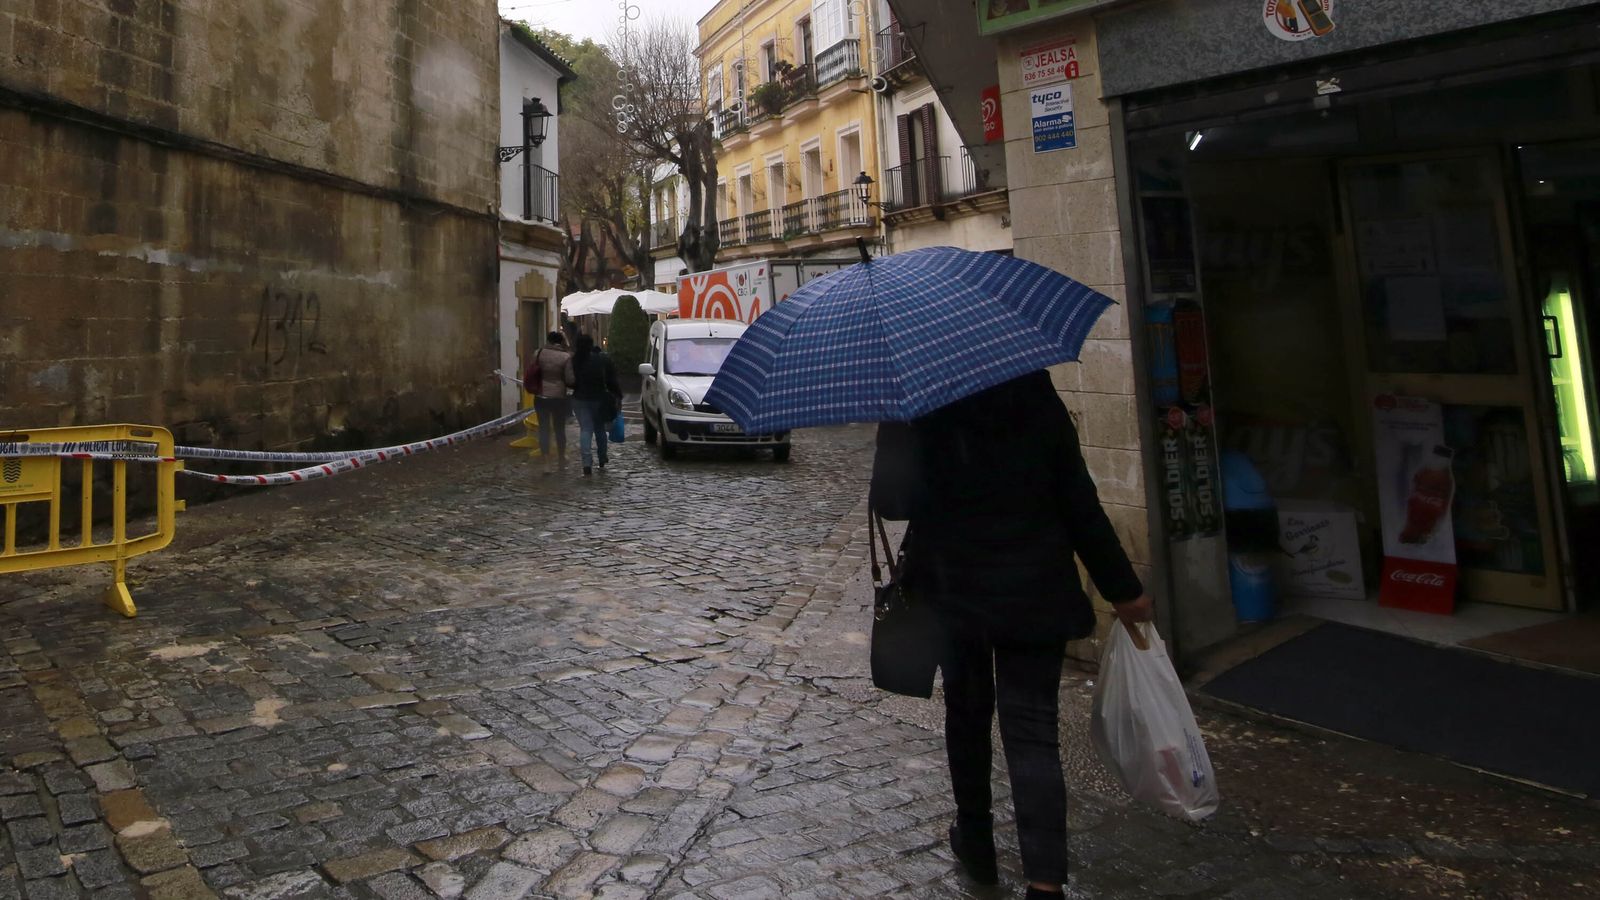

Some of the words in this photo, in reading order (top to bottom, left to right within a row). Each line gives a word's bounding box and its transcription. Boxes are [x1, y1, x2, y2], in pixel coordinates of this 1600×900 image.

[1035, 47, 1076, 68] JEALSA
[1038, 69, 1046, 78] 75
[1047, 68, 1055, 76] 58
[1056, 65, 1065, 73] 48
[1032, 90, 1062, 105] tyco
[1033, 117, 1062, 129] Alarma
[1163, 438, 1185, 521] SOLDIER
[1194, 435, 1215, 516] SOLDIER
